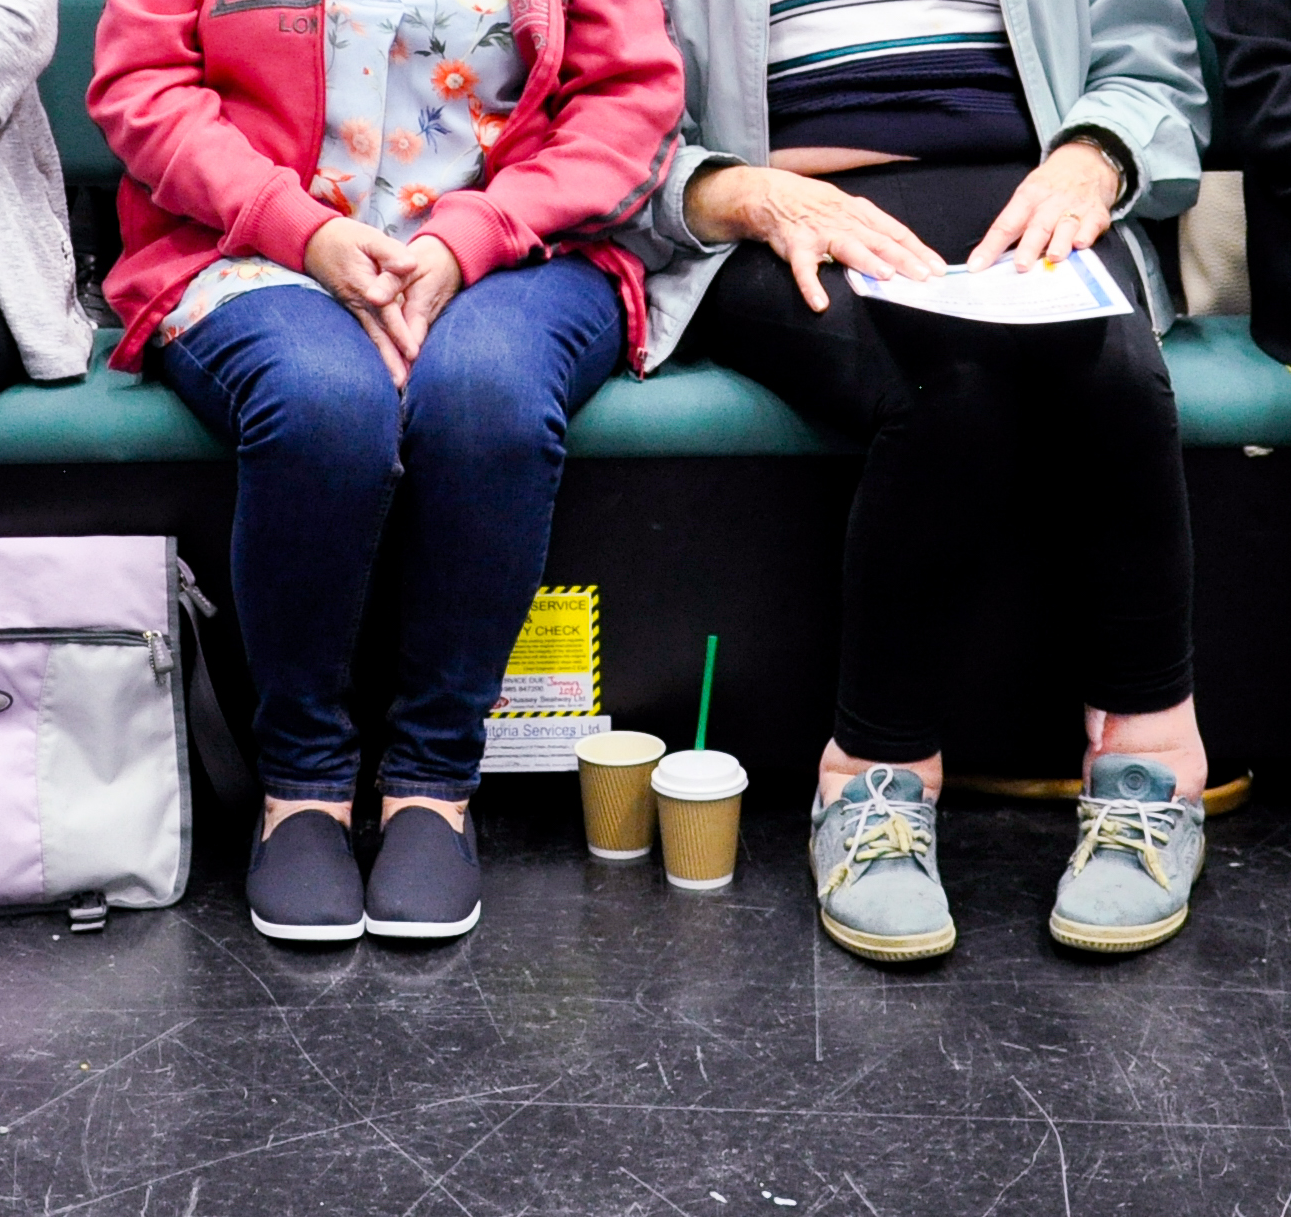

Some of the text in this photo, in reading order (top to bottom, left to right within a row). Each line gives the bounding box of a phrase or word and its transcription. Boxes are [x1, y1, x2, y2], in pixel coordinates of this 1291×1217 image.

[531, 600, 587, 611] SERVICE
[535, 625, 580, 636] CHECK
[523, 723, 577, 738] Services
[581, 723, 601, 736] Ltd
